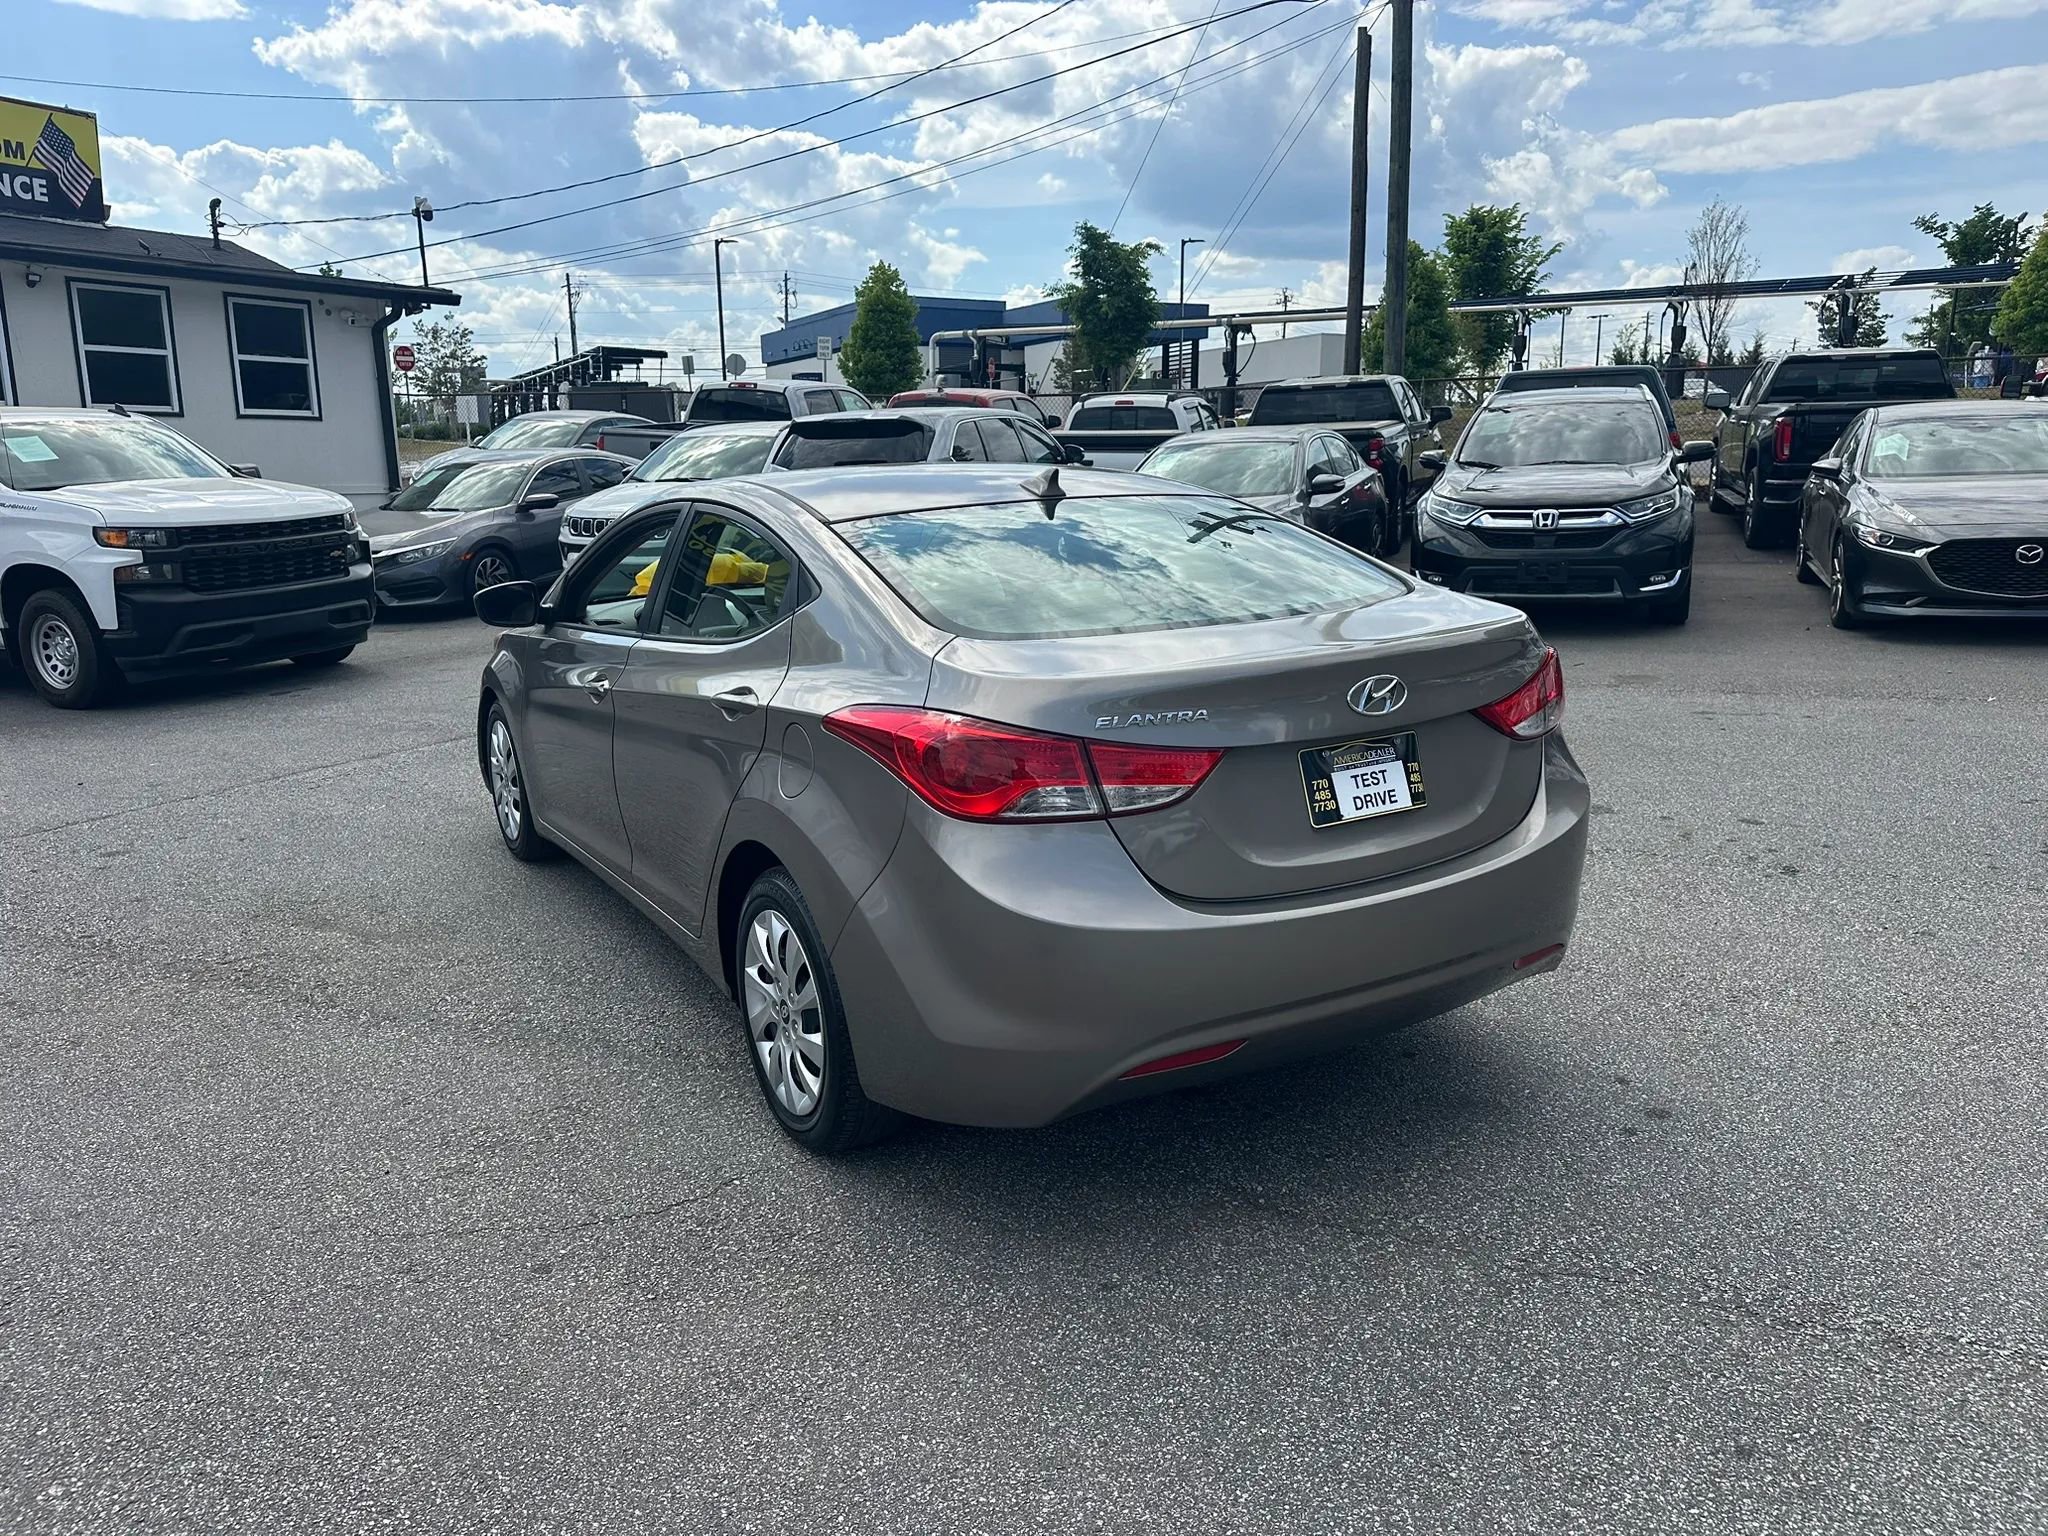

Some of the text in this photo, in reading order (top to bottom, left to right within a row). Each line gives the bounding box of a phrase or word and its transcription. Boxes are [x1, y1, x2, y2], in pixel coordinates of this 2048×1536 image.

[0, 139, 26, 161] M
[1095, 708, 1210, 730] ELANTRA
[1407, 762, 1419, 773] 770
[1350, 769, 1388, 790] TEST
[1410, 772, 1421, 783] 485
[1311, 778, 1329, 791] 770
[1410, 783, 1424, 794] 7730
[1314, 789, 1332, 801] 485
[1352, 789, 1398, 811] DRIVE
[1313, 800, 1336, 813] 7730
